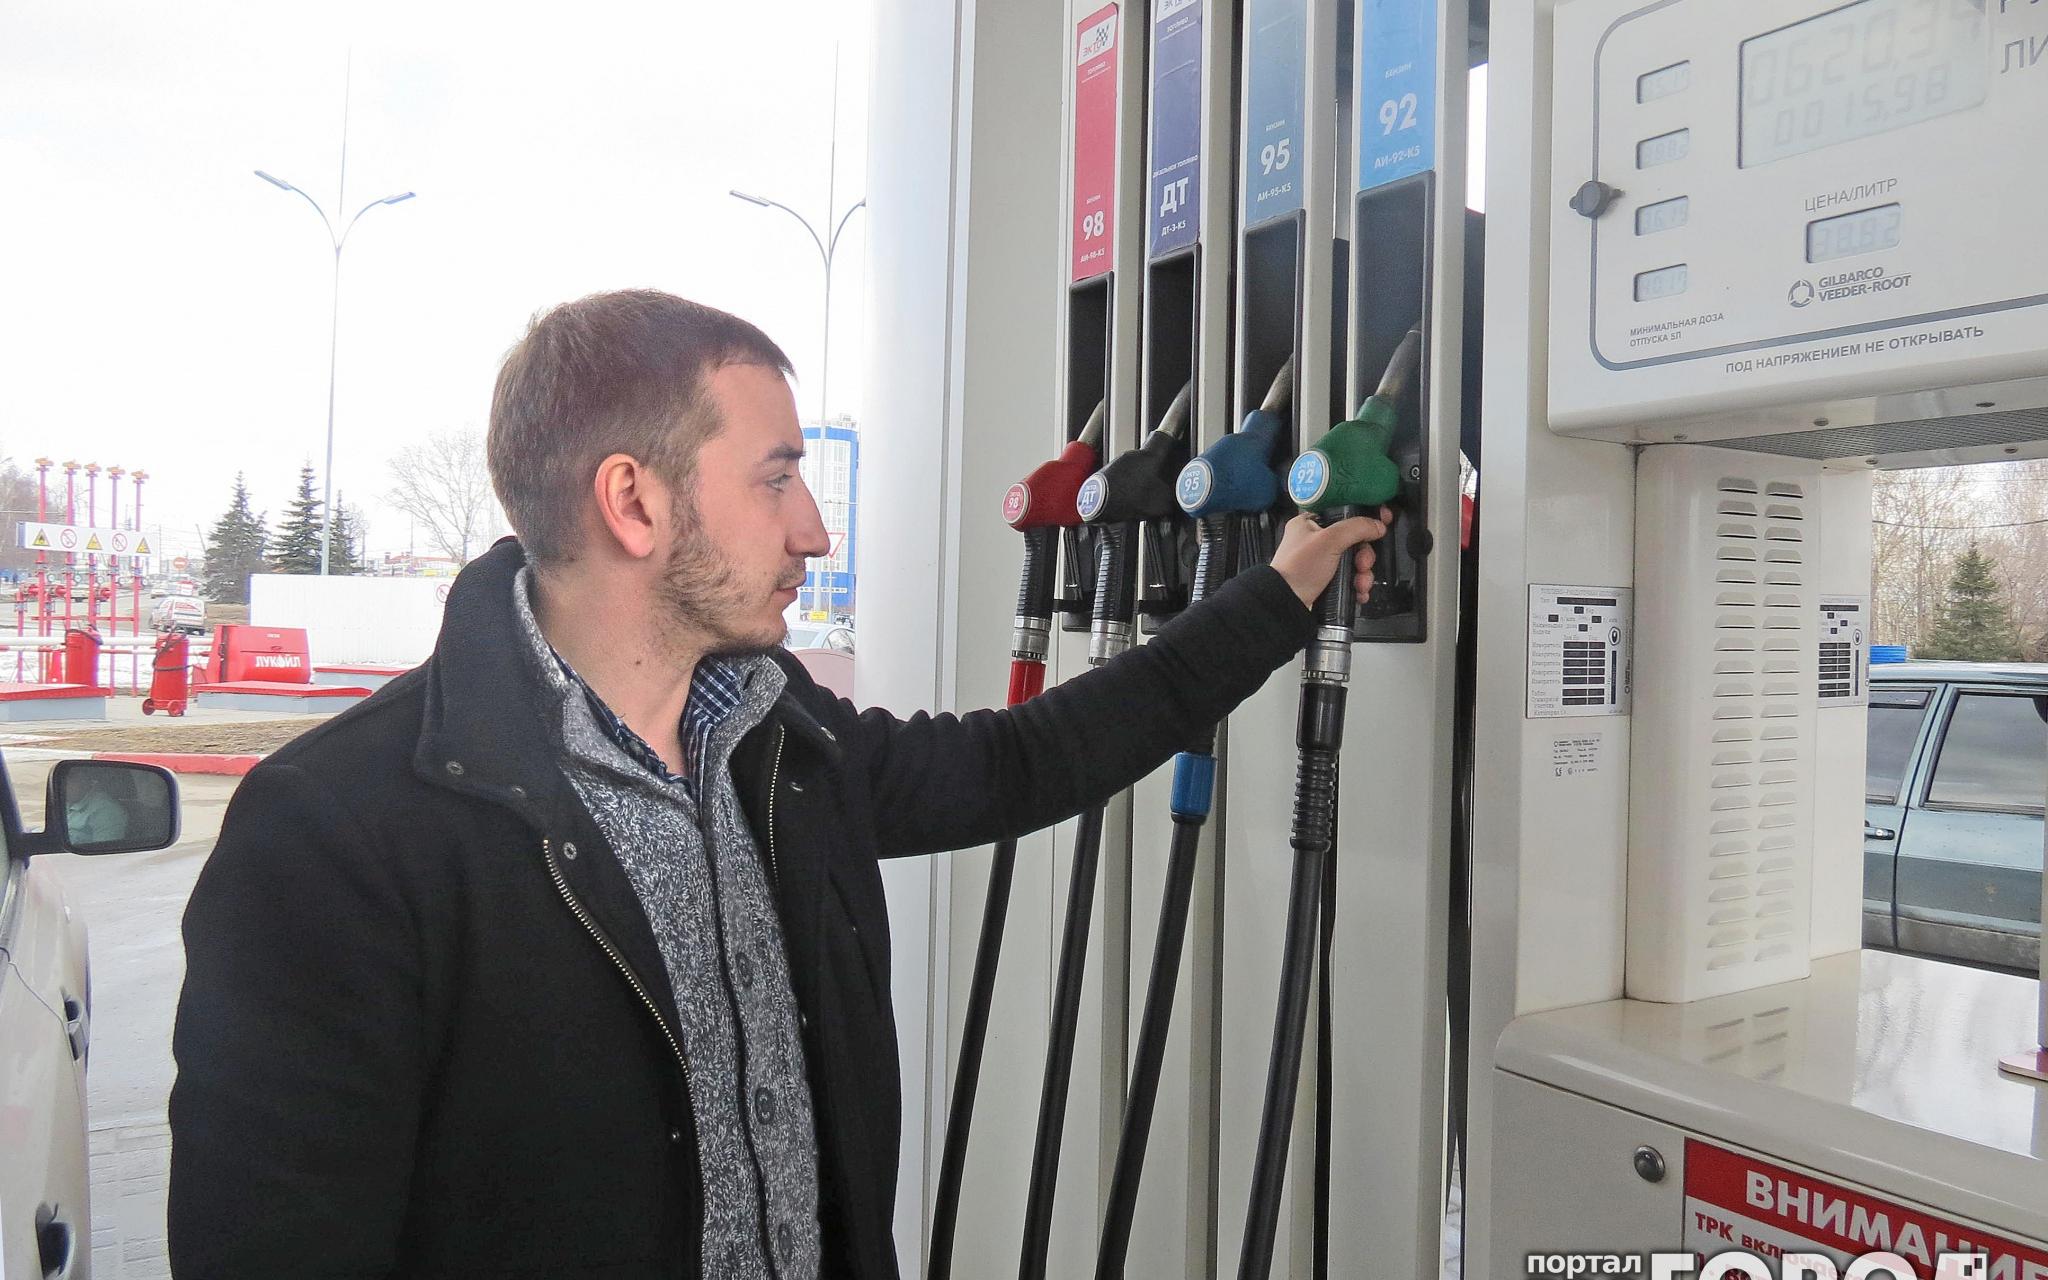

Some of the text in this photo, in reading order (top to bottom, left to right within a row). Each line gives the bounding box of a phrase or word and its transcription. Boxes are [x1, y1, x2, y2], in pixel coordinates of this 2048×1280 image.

[1380, 93, 1417, 136] 92
[1261, 138, 1290, 175] 95
[1374, 146, 1420, 169] АИ-92-К5
[1160, 176, 1189, 218] ДТ
[1257, 183, 1292, 203] АИ-95-К5
[1805, 178, 1898, 212] ЦЕНА/ЛИТР
[1083, 211, 1104, 240] 98
[1819, 266, 1884, 288] GILBARCO
[1819, 275, 1911, 301] VEEDER-ROOT
[1630, 313, 1724, 336] МИНИМАЛЬНАЯ ДОЗА
[1630, 334, 1668, 347] ОТПУСКА
[1725, 325, 1984, 374] ПОД НАПРЯЖЕНИЕМ НЕ ОТКРЫВАТЬ
[1185, 476, 1200, 493] 95
[1297, 468, 1314, 485] 92
[1008, 497, 1019, 509] 98
[1081, 490, 1097, 506] ДТ
[1695, 1211, 1734, 1242] ТРК
